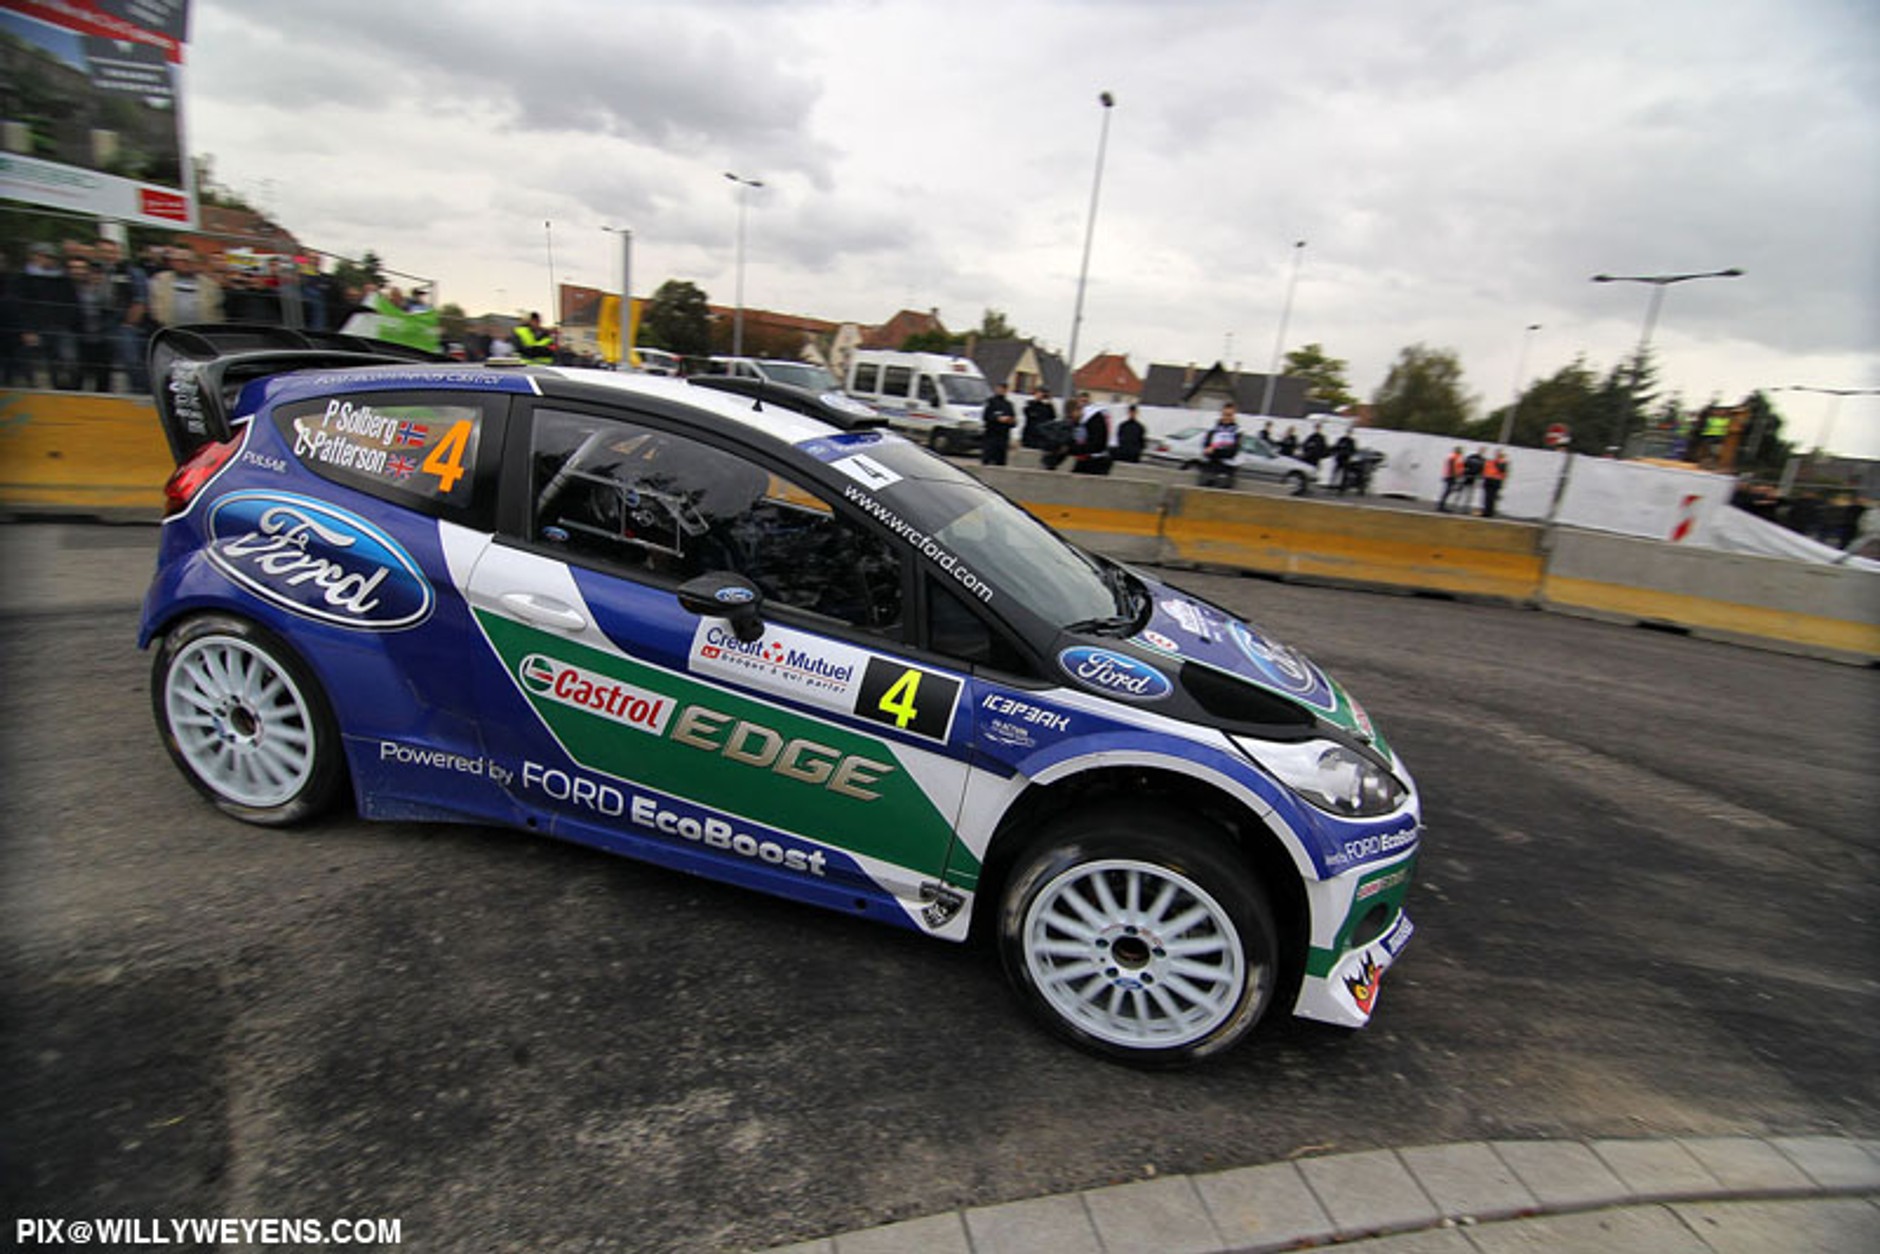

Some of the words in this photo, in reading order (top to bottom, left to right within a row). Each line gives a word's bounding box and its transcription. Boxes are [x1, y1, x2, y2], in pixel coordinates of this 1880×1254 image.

[310, 431, 387, 474] Patterson
[323, 400, 340, 428] P
[337, 402, 399, 446] Solberg
[422, 420, 473, 493] 4
[222, 504, 391, 613] Ford
[844, 485, 995, 603] www.wrcford.com
[785, 650, 854, 683] Mutuel
[1077, 651, 1153, 695] Ford
[878, 669, 922, 729] 4
[553, 669, 664, 730] Castrol
[670, 703, 898, 802] EDGE
[380, 741, 483, 774] Powered
[488, 759, 514, 785] by
[522, 760, 624, 817] FORD
[631, 795, 828, 878] EcoBoost
[1344, 835, 1381, 861] FORD
